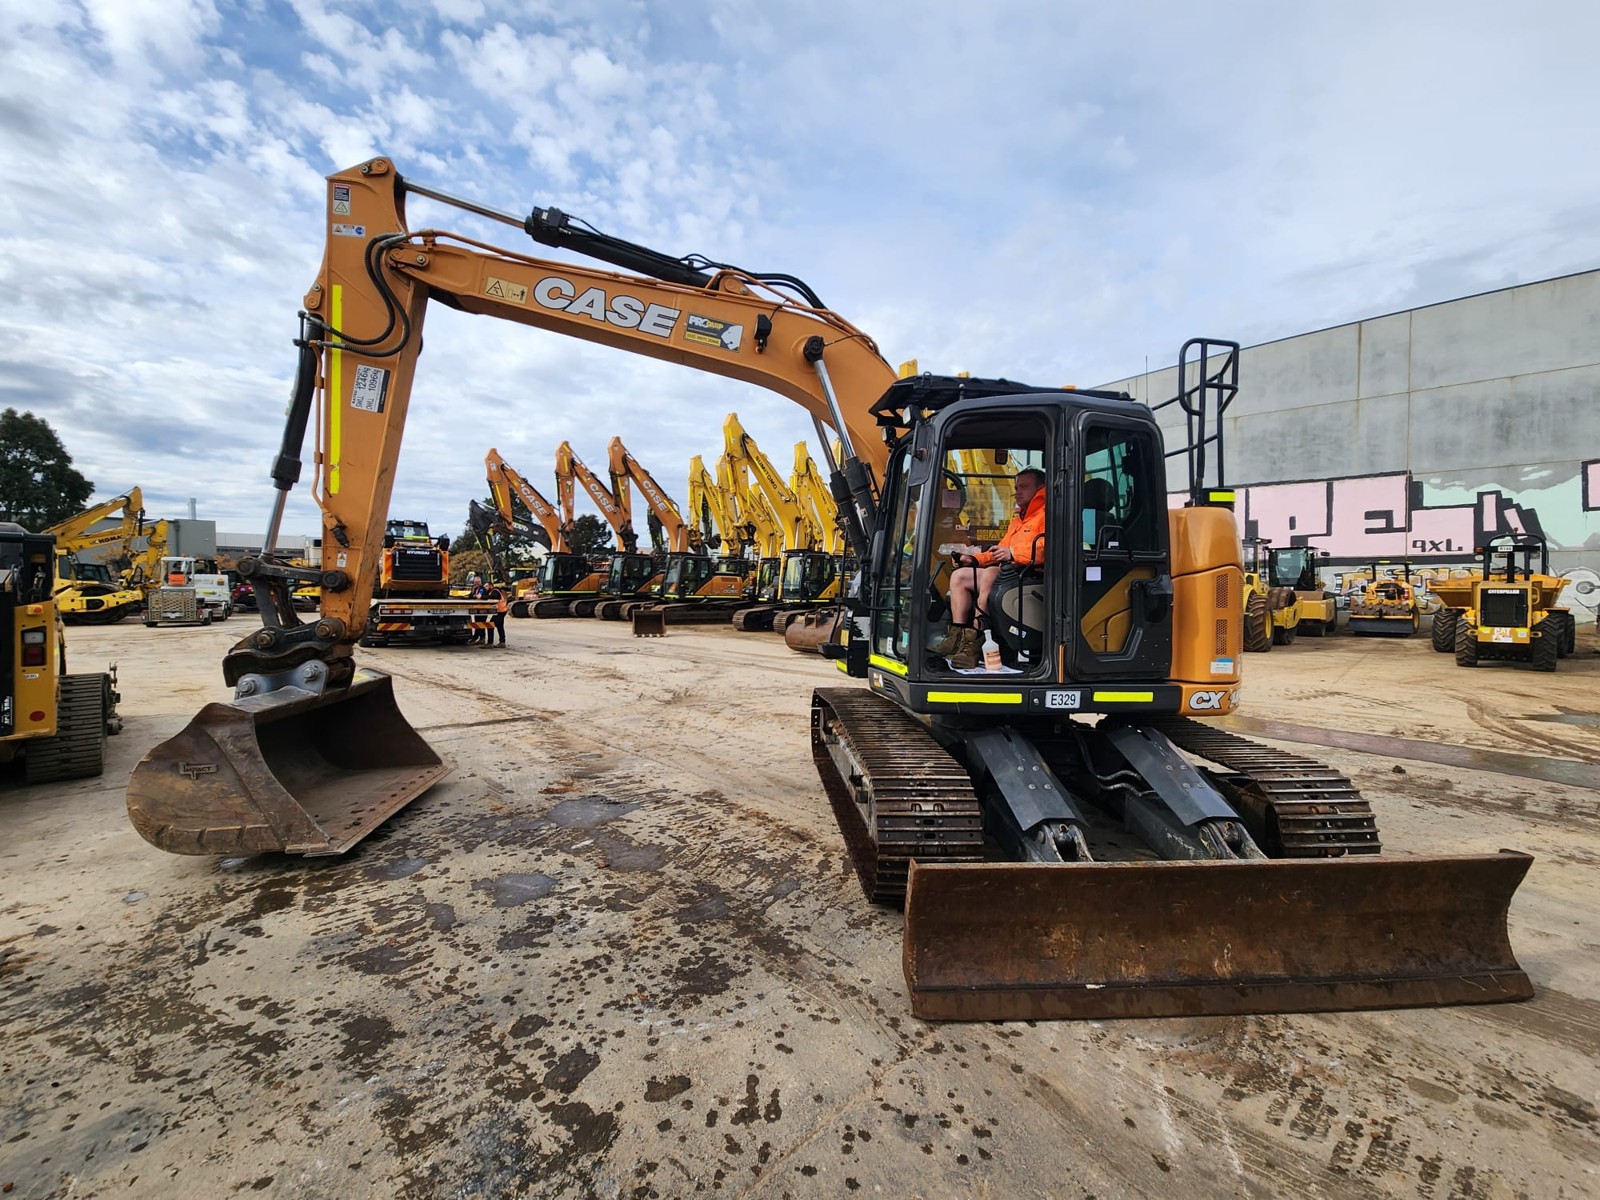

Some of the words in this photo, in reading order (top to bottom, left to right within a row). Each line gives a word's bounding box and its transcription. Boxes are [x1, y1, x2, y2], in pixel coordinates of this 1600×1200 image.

[534, 276, 681, 338] CASE
[755, 455, 778, 490] SUMITOMO
[521, 486, 549, 516] CASE
[589, 483, 616, 513] CASE
[642, 480, 668, 511] CASE
[1051, 694, 1077, 706] E329
[1189, 691, 1228, 710] CX
